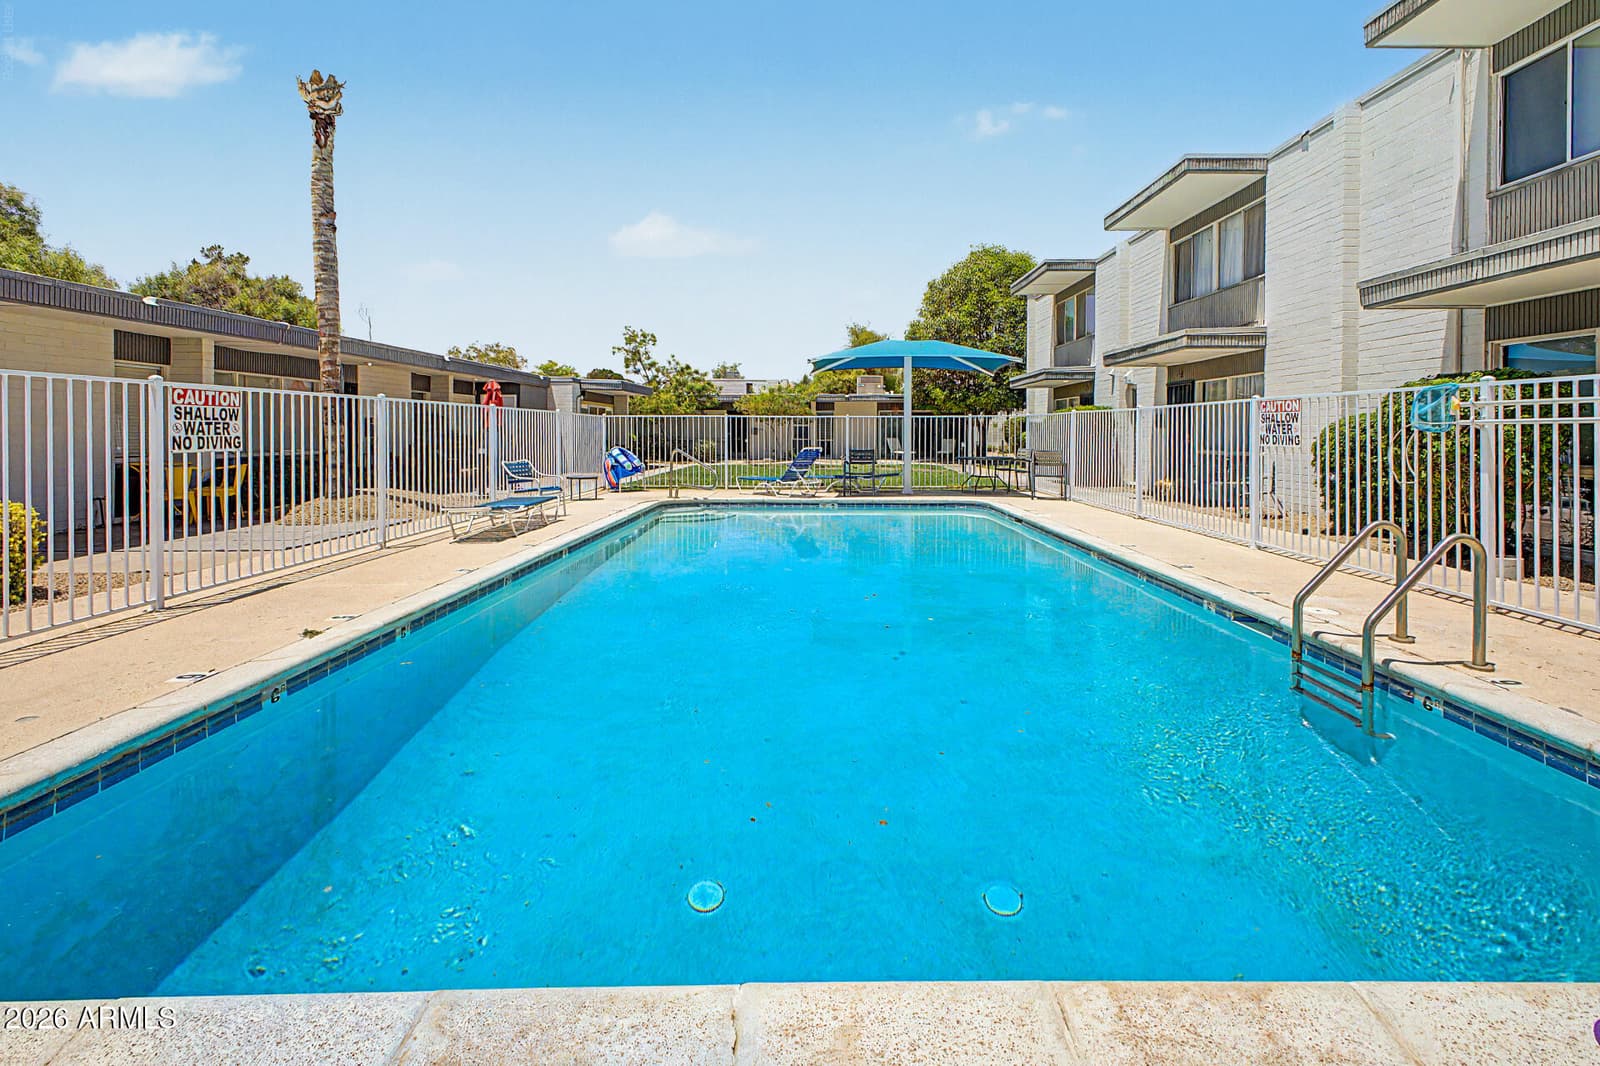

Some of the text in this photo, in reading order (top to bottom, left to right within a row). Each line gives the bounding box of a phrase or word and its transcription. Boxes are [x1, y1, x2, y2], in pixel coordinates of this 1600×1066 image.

[173, 388, 240, 407] CAUTION
[1260, 400, 1299, 412] CAUTION
[174, 406, 240, 421] SHALLOW
[1260, 412, 1299, 424] SHALLOW
[183, 422, 231, 435] WATER
[1265, 424, 1293, 434] WATER
[172, 435, 242, 450] NO DIVING
[1260, 434, 1300, 446] NO DIVING
[271, 687, 280, 703] 6
[1422, 695, 1433, 712] 6
